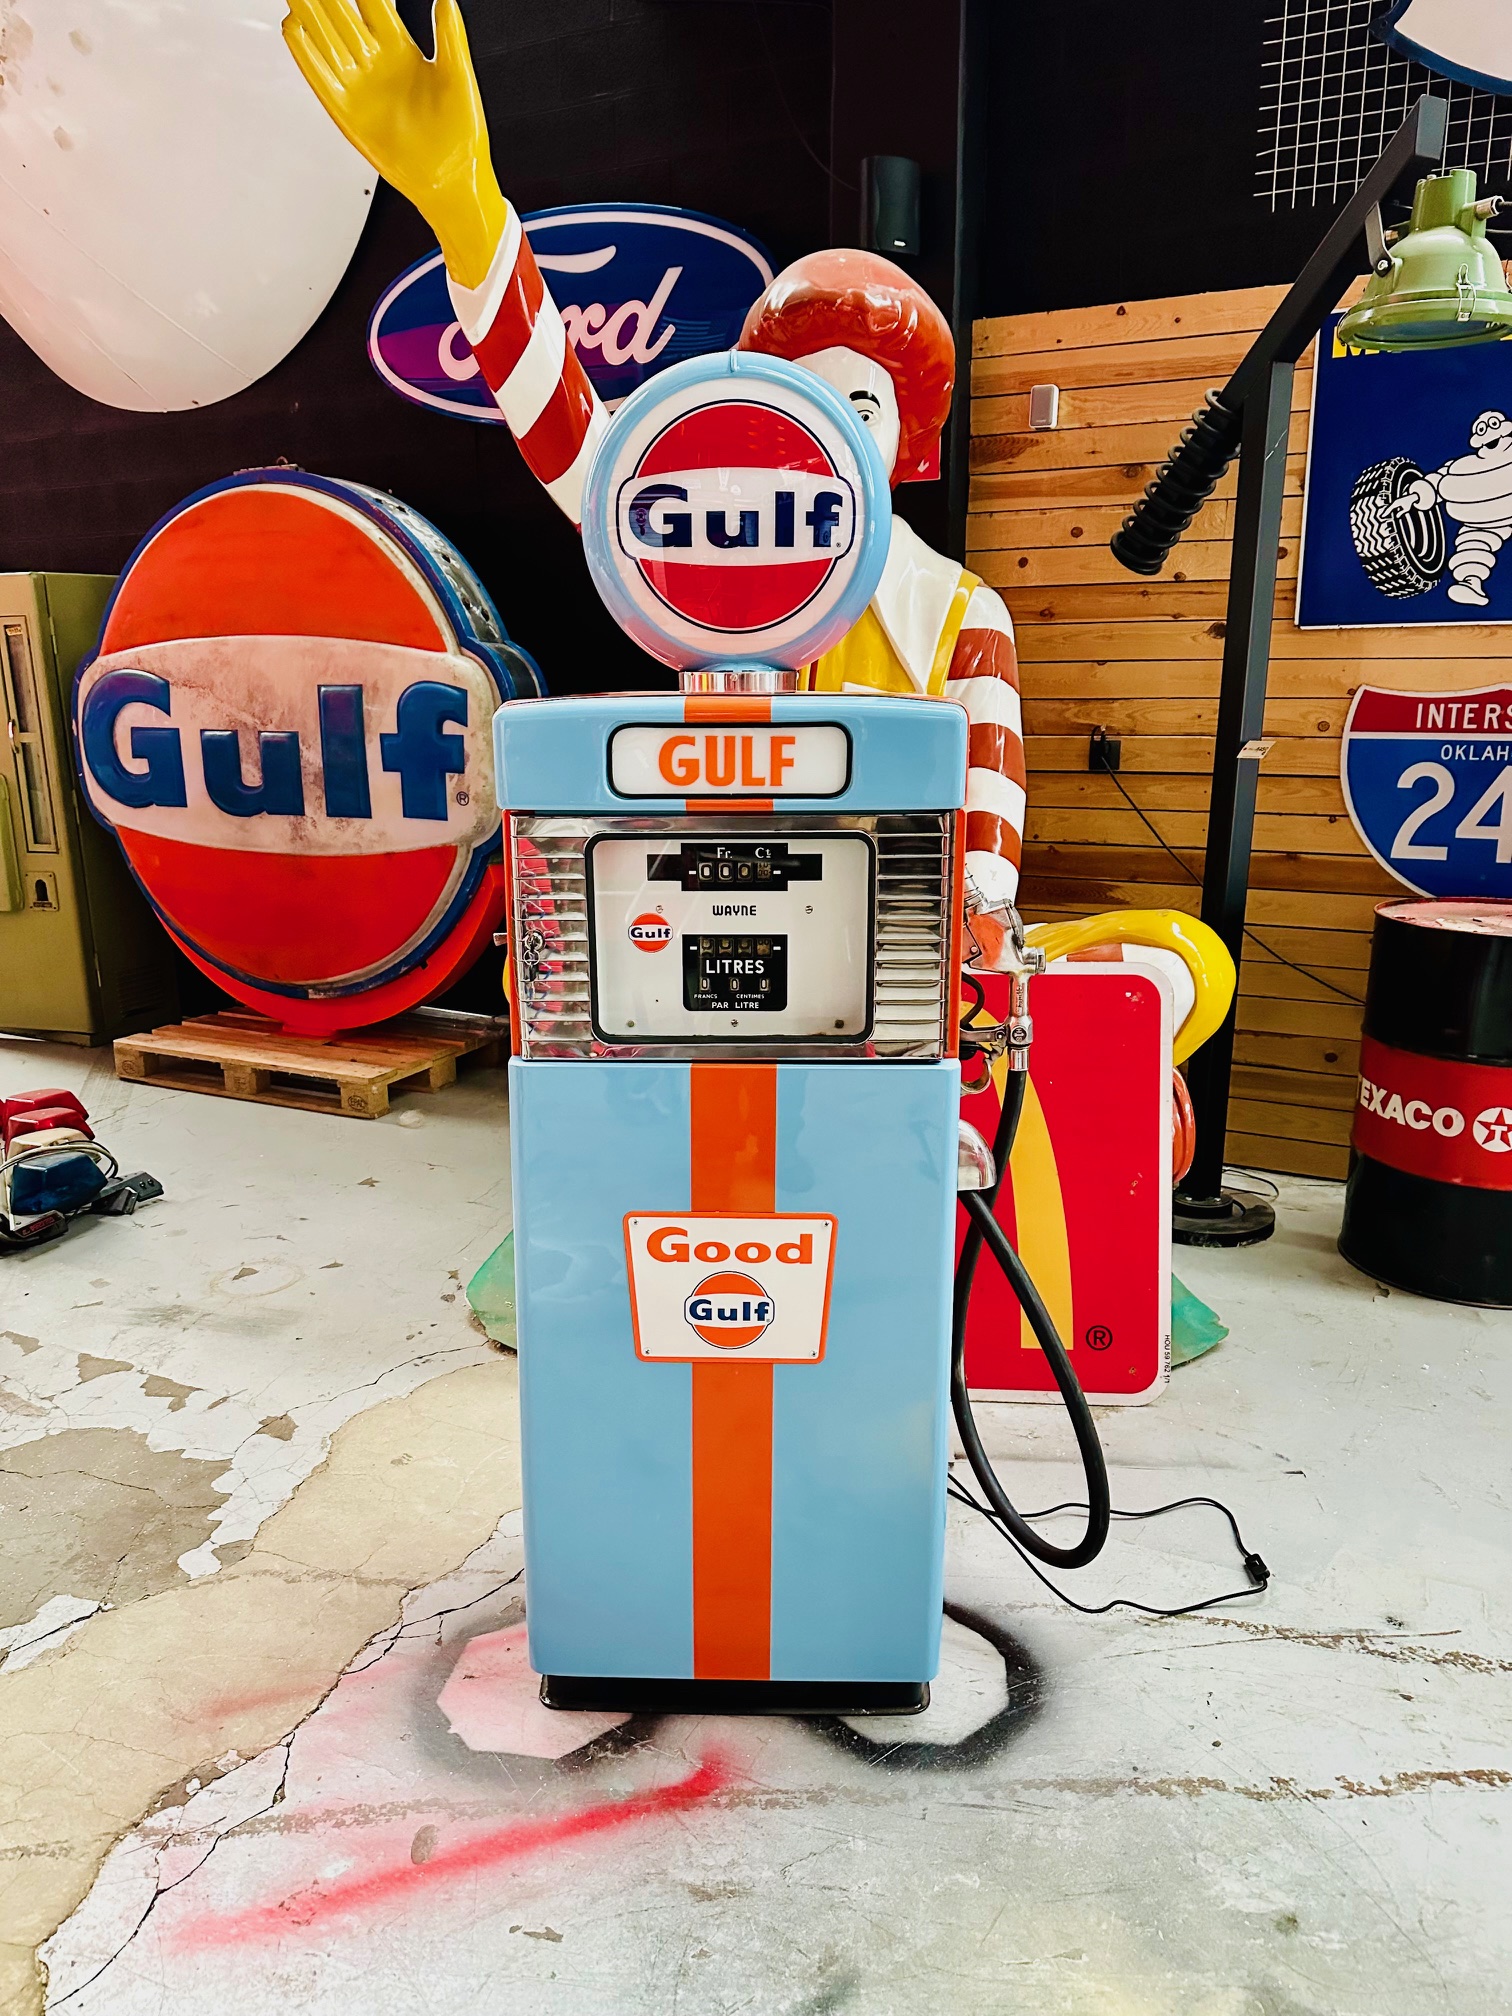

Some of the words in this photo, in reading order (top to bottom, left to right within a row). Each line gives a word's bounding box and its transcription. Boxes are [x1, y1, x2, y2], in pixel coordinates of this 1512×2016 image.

[629, 483, 843, 549] Gulf
[82, 668, 468, 821] Gulf
[1441, 744, 1512, 761] OKLAH
[658, 735, 796, 787] GULF
[712, 905, 757, 916] WAYNE
[630, 927, 671, 939] Gulf
[706, 959, 765, 974] LITRES
[646, 1226, 813, 1265] Good
[689, 1298, 770, 1322] Gulf
